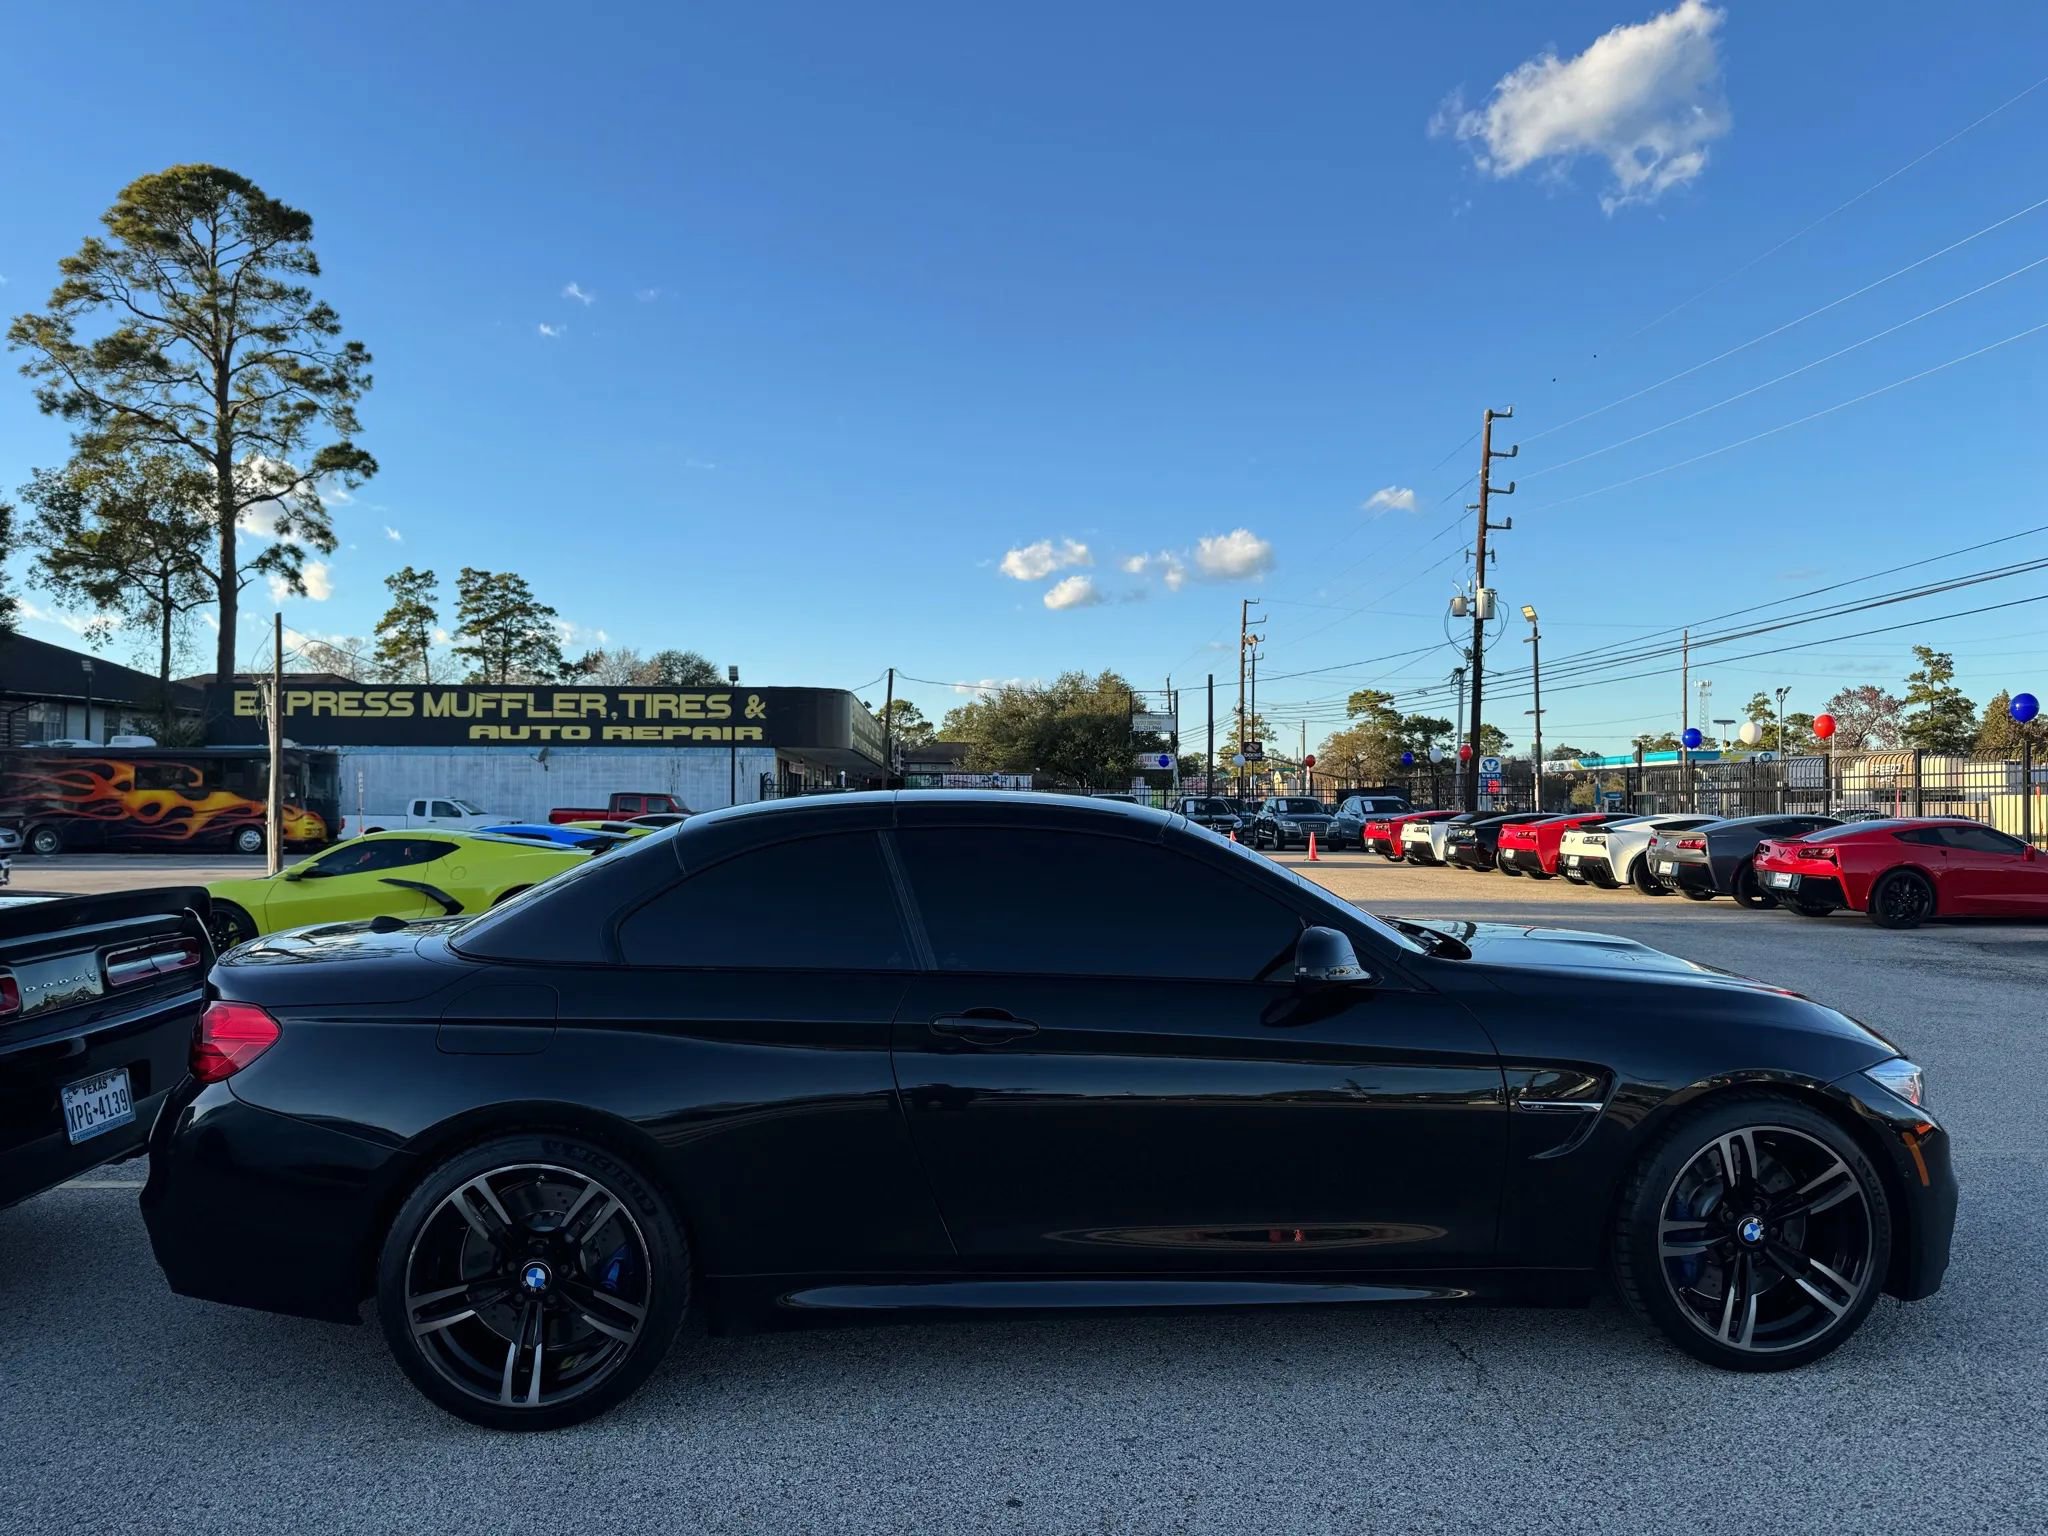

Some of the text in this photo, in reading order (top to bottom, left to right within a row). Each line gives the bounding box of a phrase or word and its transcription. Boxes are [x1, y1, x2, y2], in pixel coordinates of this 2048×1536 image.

[233, 690, 416, 718] EPRESS
[744, 694, 768, 719] &
[468, 725, 763, 741] AUTO REPAIR
[82, 1080, 108, 1096] TEXAS
